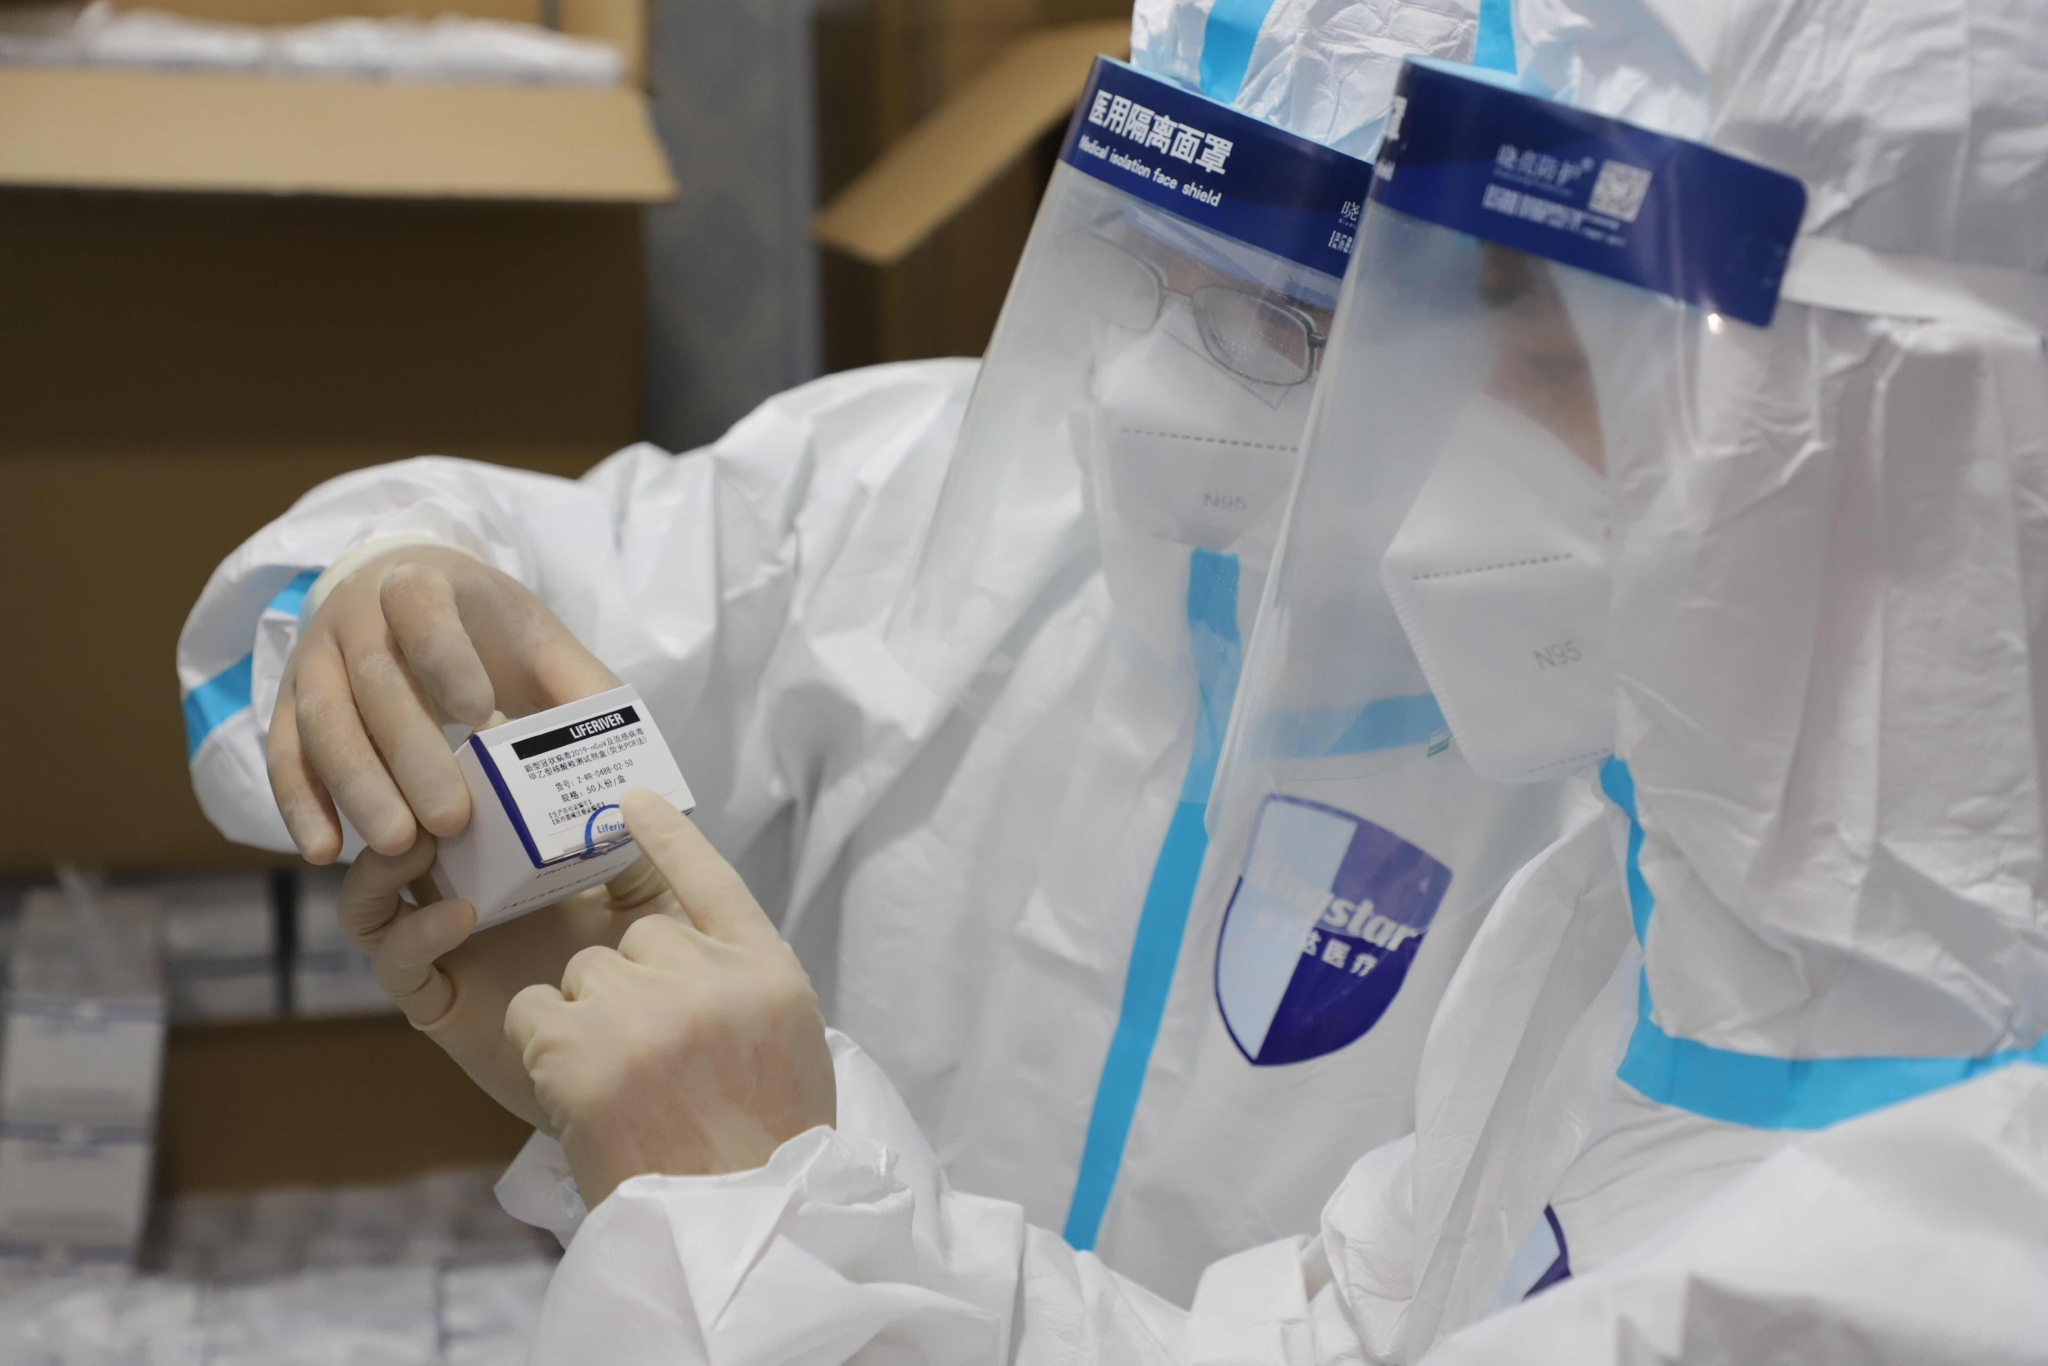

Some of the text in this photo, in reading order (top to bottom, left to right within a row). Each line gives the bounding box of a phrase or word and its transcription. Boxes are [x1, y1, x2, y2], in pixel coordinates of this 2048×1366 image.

[1088, 89, 1233, 175] 医用隔离面罩
[1078, 134, 1222, 207] Medical isolation face shield
[1341, 200, 1361, 221] 晓
[1202, 492, 1248, 511] N95
[1533, 639, 1582, 670] N95
[569, 712, 625, 739] LIFERIVER
[597, 821, 625, 834] Liferiv
